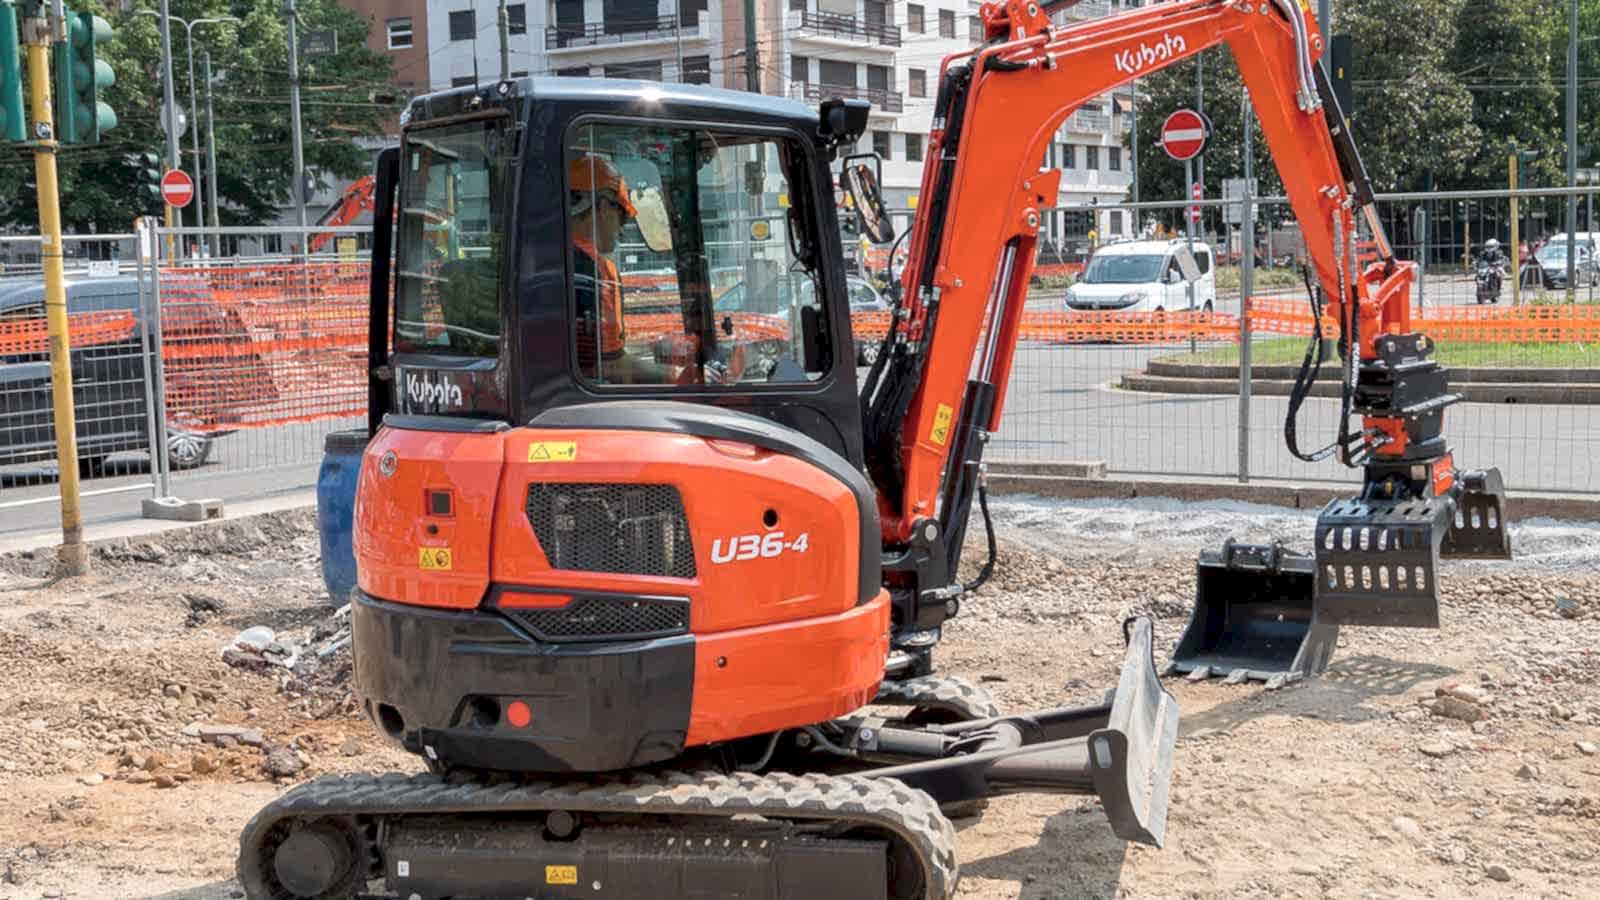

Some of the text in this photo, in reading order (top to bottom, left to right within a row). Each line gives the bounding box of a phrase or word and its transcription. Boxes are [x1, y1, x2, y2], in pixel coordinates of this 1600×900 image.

[1114, 32, 1186, 74] Kubota
[406, 373, 463, 406] Kubota
[710, 531, 809, 564] U36-4
